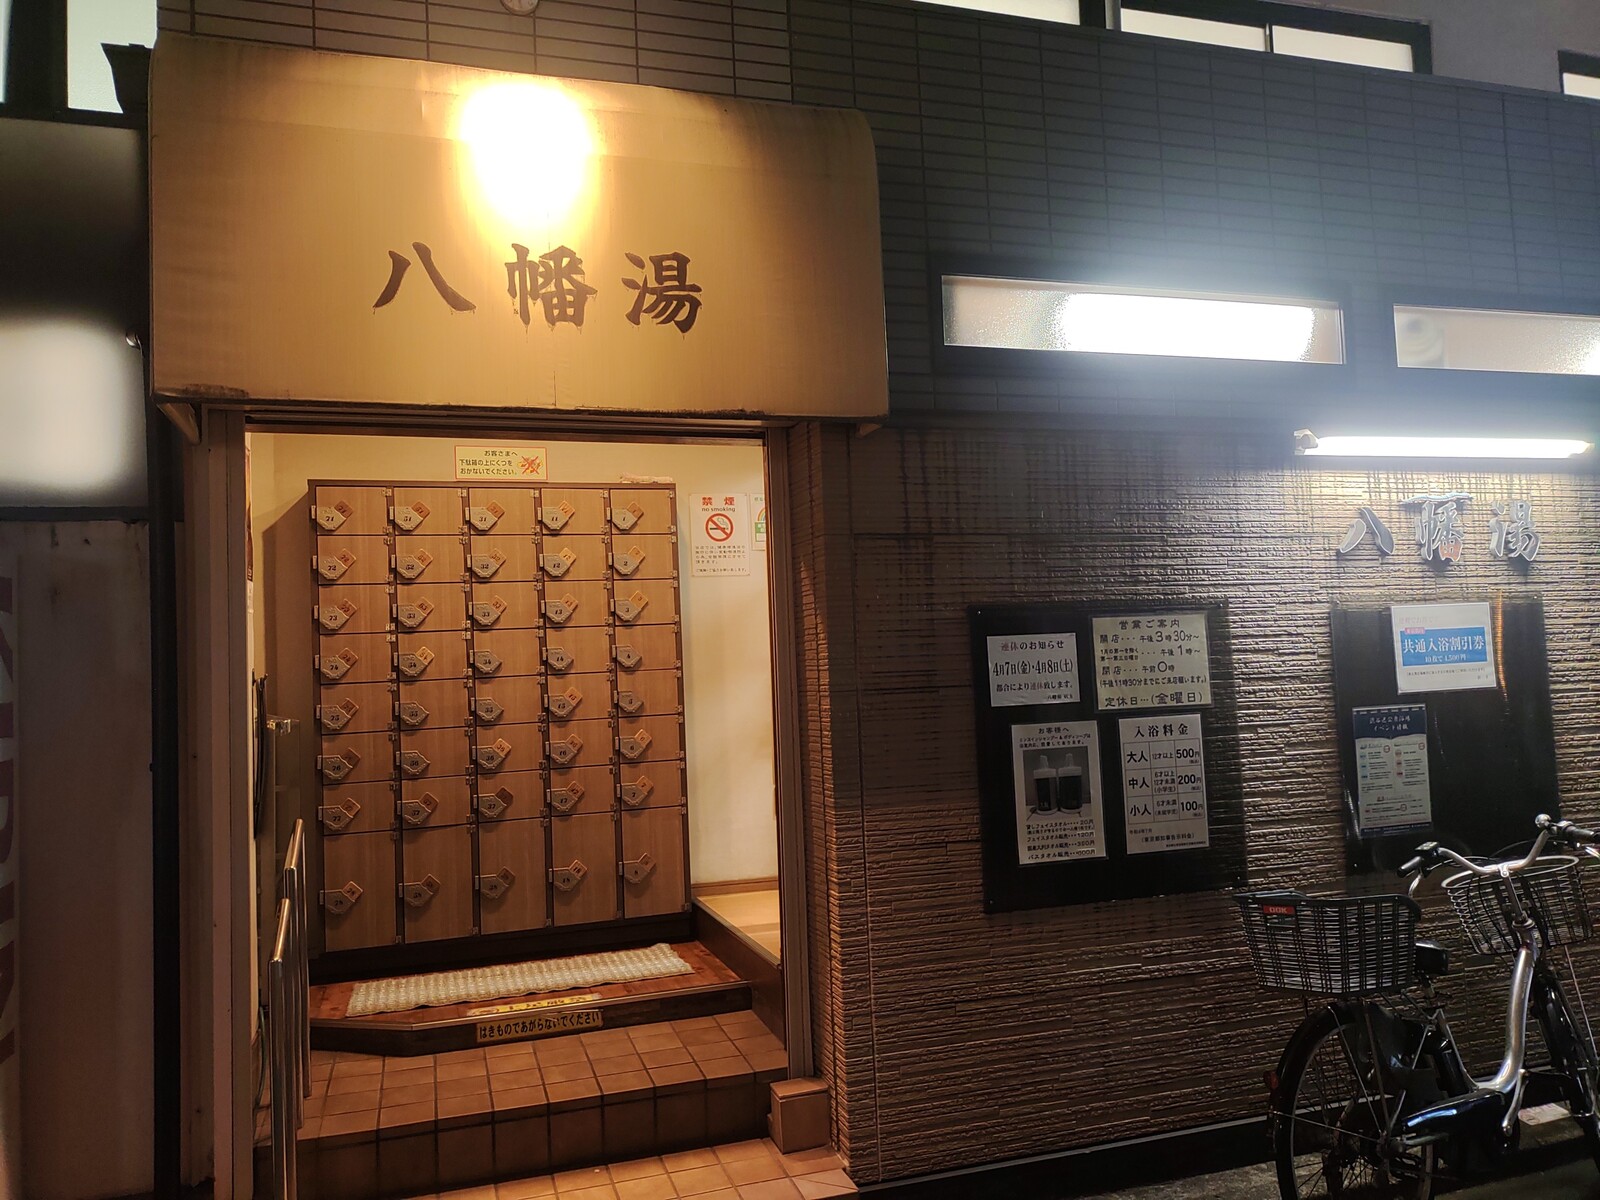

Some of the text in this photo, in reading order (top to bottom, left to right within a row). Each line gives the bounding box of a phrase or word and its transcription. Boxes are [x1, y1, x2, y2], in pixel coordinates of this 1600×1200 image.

[372, 241, 703, 334] 八幡湯
[459, 459, 513, 467] 下駄箱の上にくつを
[701, 496, 735, 506] 禁煙
[1339, 500, 1541, 562] 八幡湯
[1119, 618, 1181, 630] 営業ご案内
[1001, 640, 1065, 652] 連休のお知らせ
[1403, 635, 1485, 654] 共通入浴割引券
[1038, 726, 1070, 735] お客様へ
[1134, 723, 1189, 738] 入浴料金
[1126, 750, 1149, 763] 大人
[1176, 748, 1200, 759] 500円
[1155, 770, 1175, 778] 6才以上
[1177, 774, 1202, 785] 200円
[1128, 777, 1150, 789] 中人
[1130, 803, 1152, 816] 小人
[1180, 801, 1204, 812] 100円
[479, 1011, 600, 1040] はきものであがらないでください
